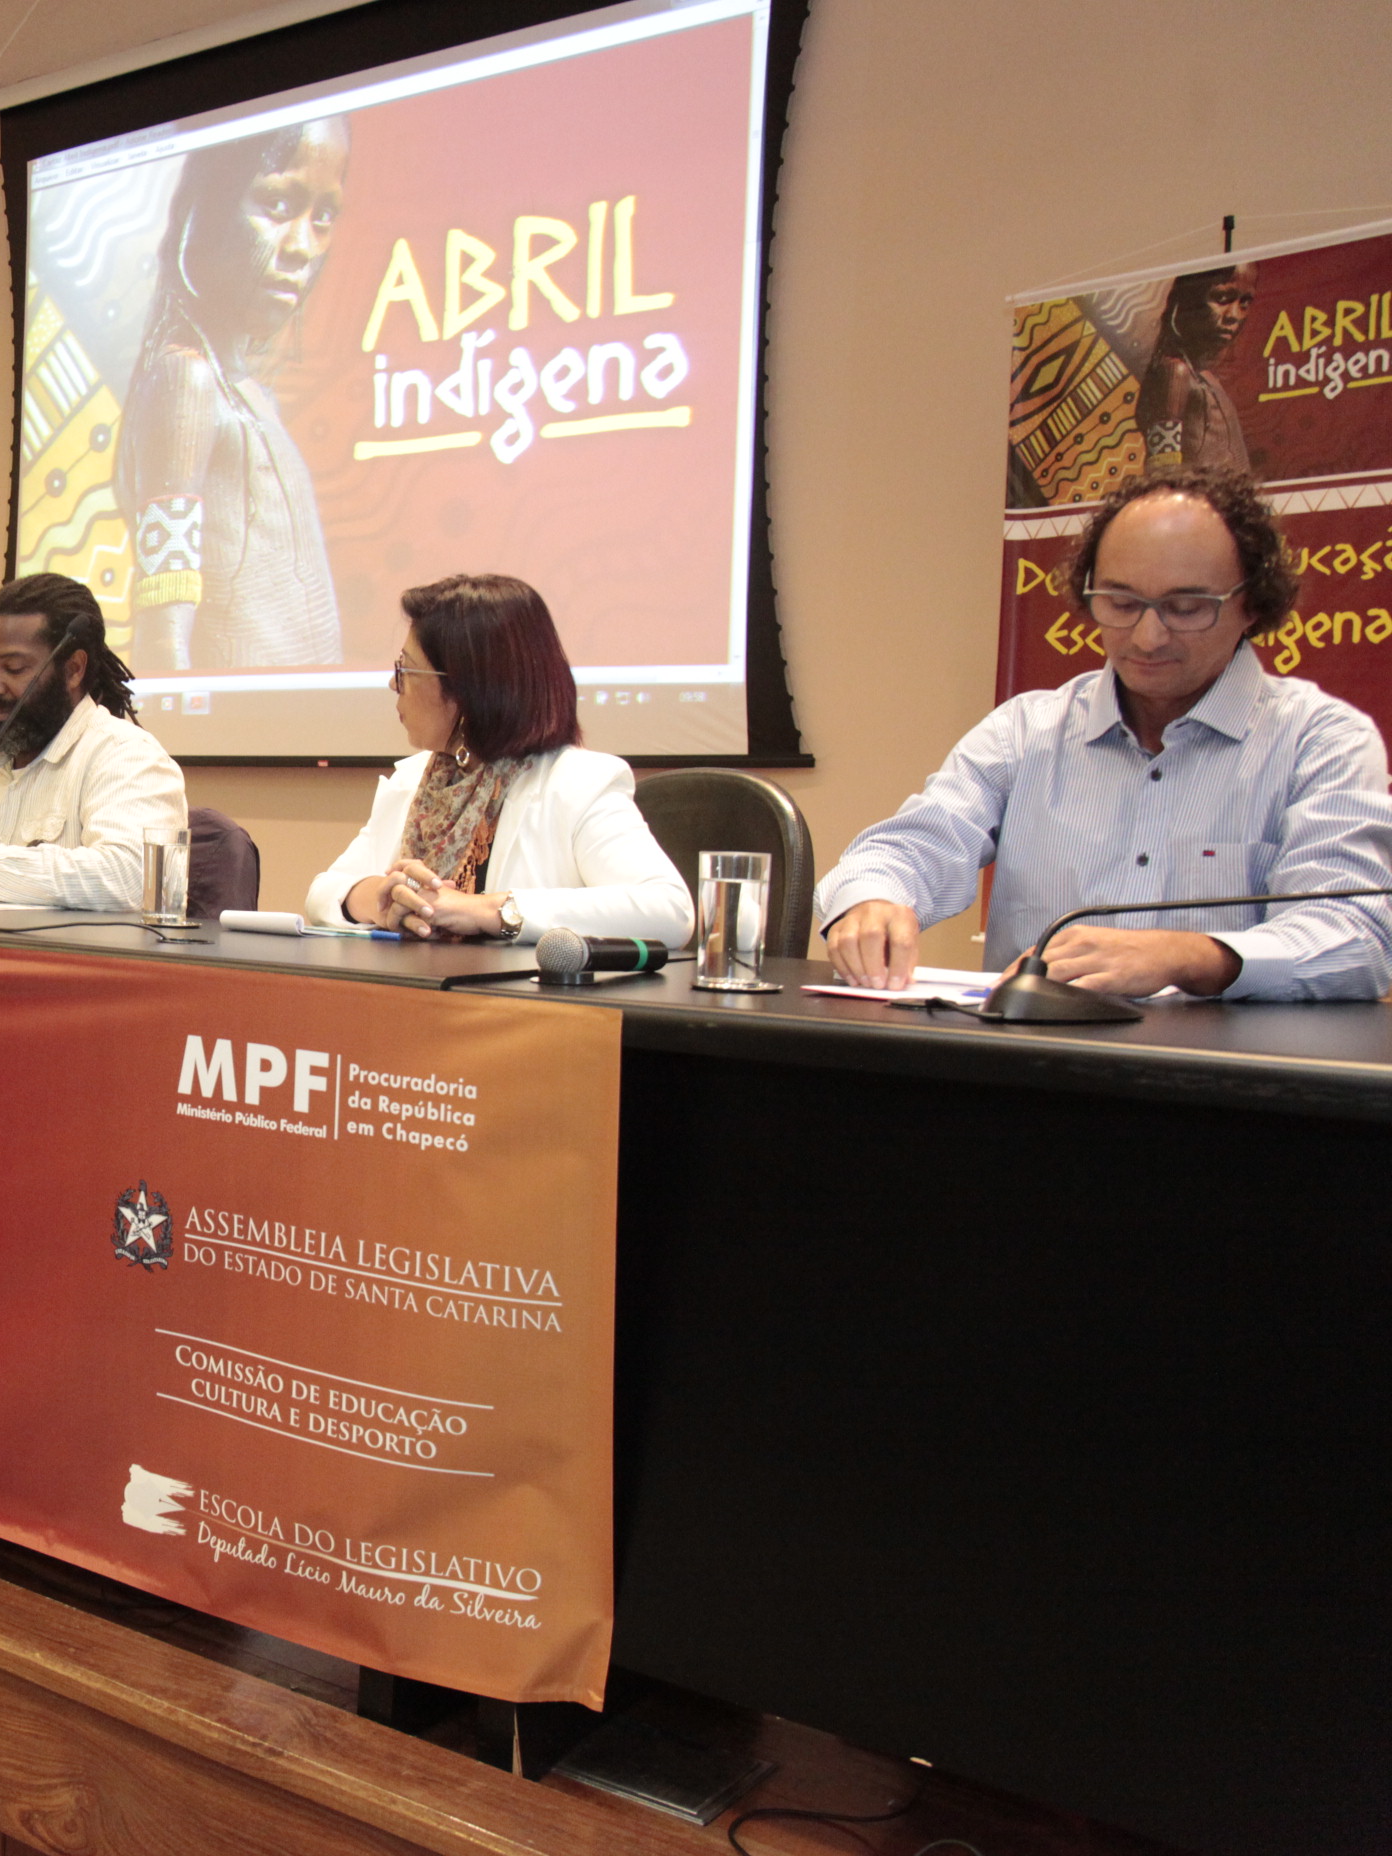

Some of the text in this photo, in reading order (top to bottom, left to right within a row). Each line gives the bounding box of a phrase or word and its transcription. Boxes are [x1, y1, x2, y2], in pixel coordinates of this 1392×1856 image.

[361, 194, 675, 352] ABRIL
[372, 330, 689, 464] indígena
[1268, 345, 1392, 400] indígen
[177, 1034, 330, 1113] MPF
[347, 1090, 476, 1127] da República
[348, 1063, 477, 1100] Procuradoria
[176, 1102, 327, 1140] Ministério Público Federal
[346, 1119, 469, 1152] em Chapecó
[183, 1244, 562, 1333] DO ESTADO DE SANTA CATARINA
[184, 1206, 561, 1297] ASSEMBLEIA LEGISLATIVA
[191, 1378, 437, 1459] CULTURA E DESPORTO
[291, 1380, 321, 1406] DE
[328, 1390, 467, 1436] EDUCAÇÃO
[197, 1521, 541, 1630] Deputado Lício Mauro da Silveira
[199, 1489, 542, 1592] ESCOLA DO LEGISLATIVO
